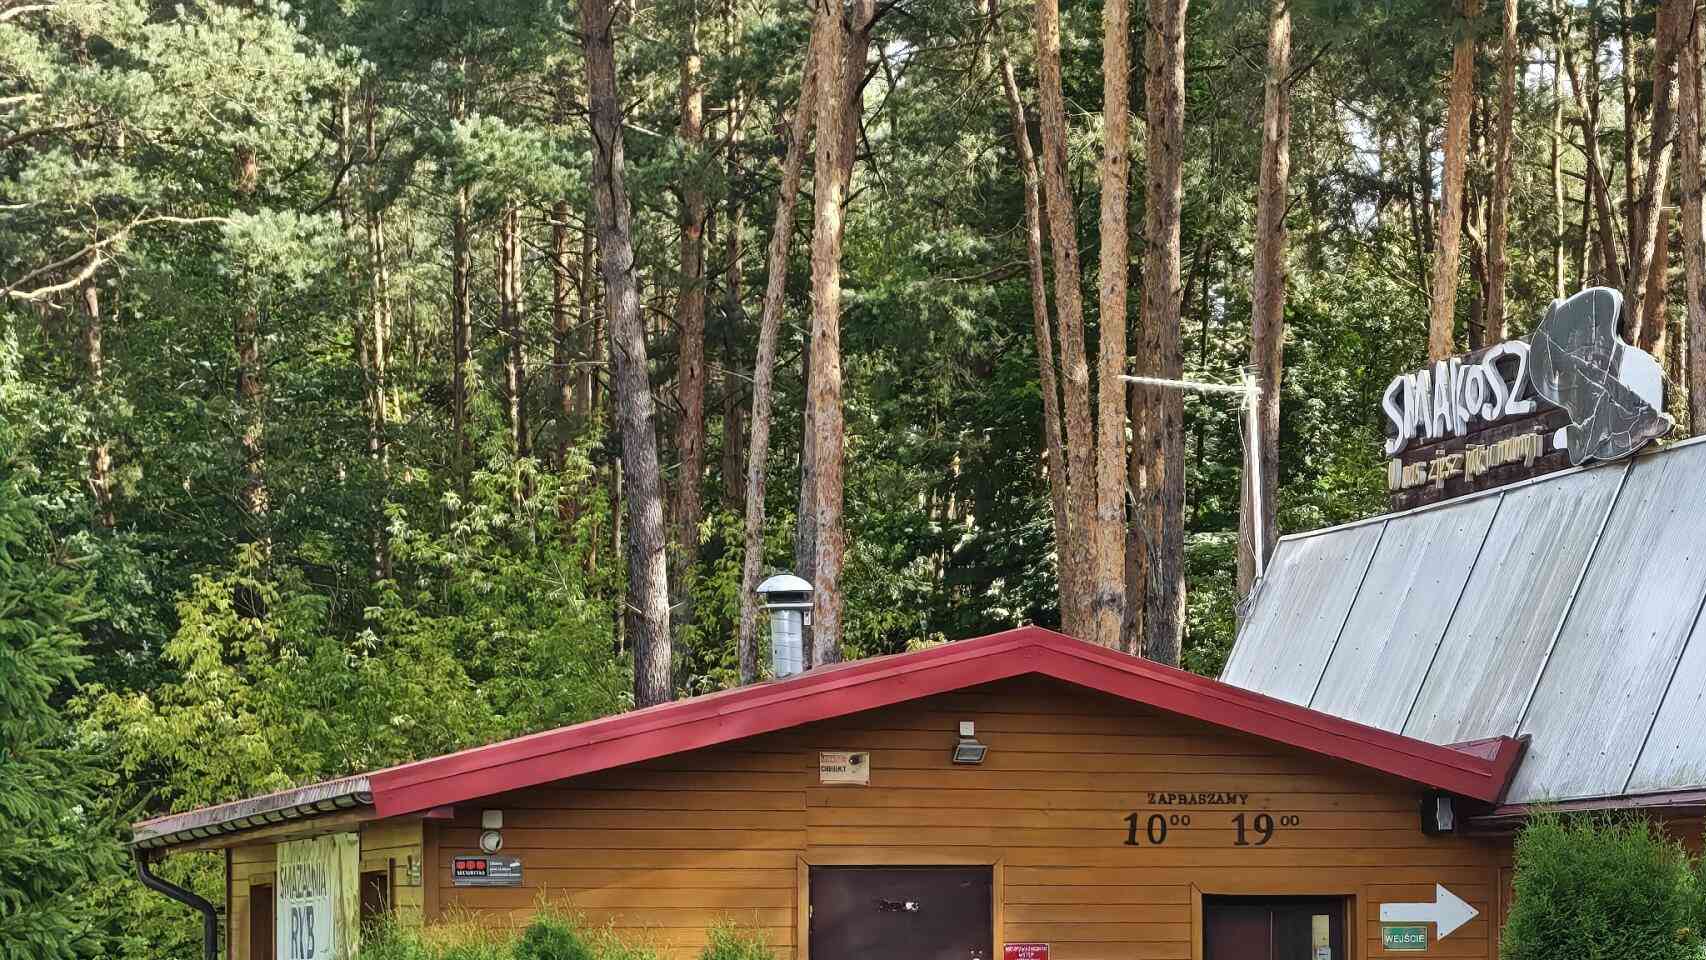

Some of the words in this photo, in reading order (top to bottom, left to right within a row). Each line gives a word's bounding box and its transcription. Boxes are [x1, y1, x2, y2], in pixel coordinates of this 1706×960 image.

[1147, 792, 1249, 805] ZAPRASZAMY
[290, 905, 315, 960] RYB
[1385, 931, 1425, 943] WEJŚCIE
